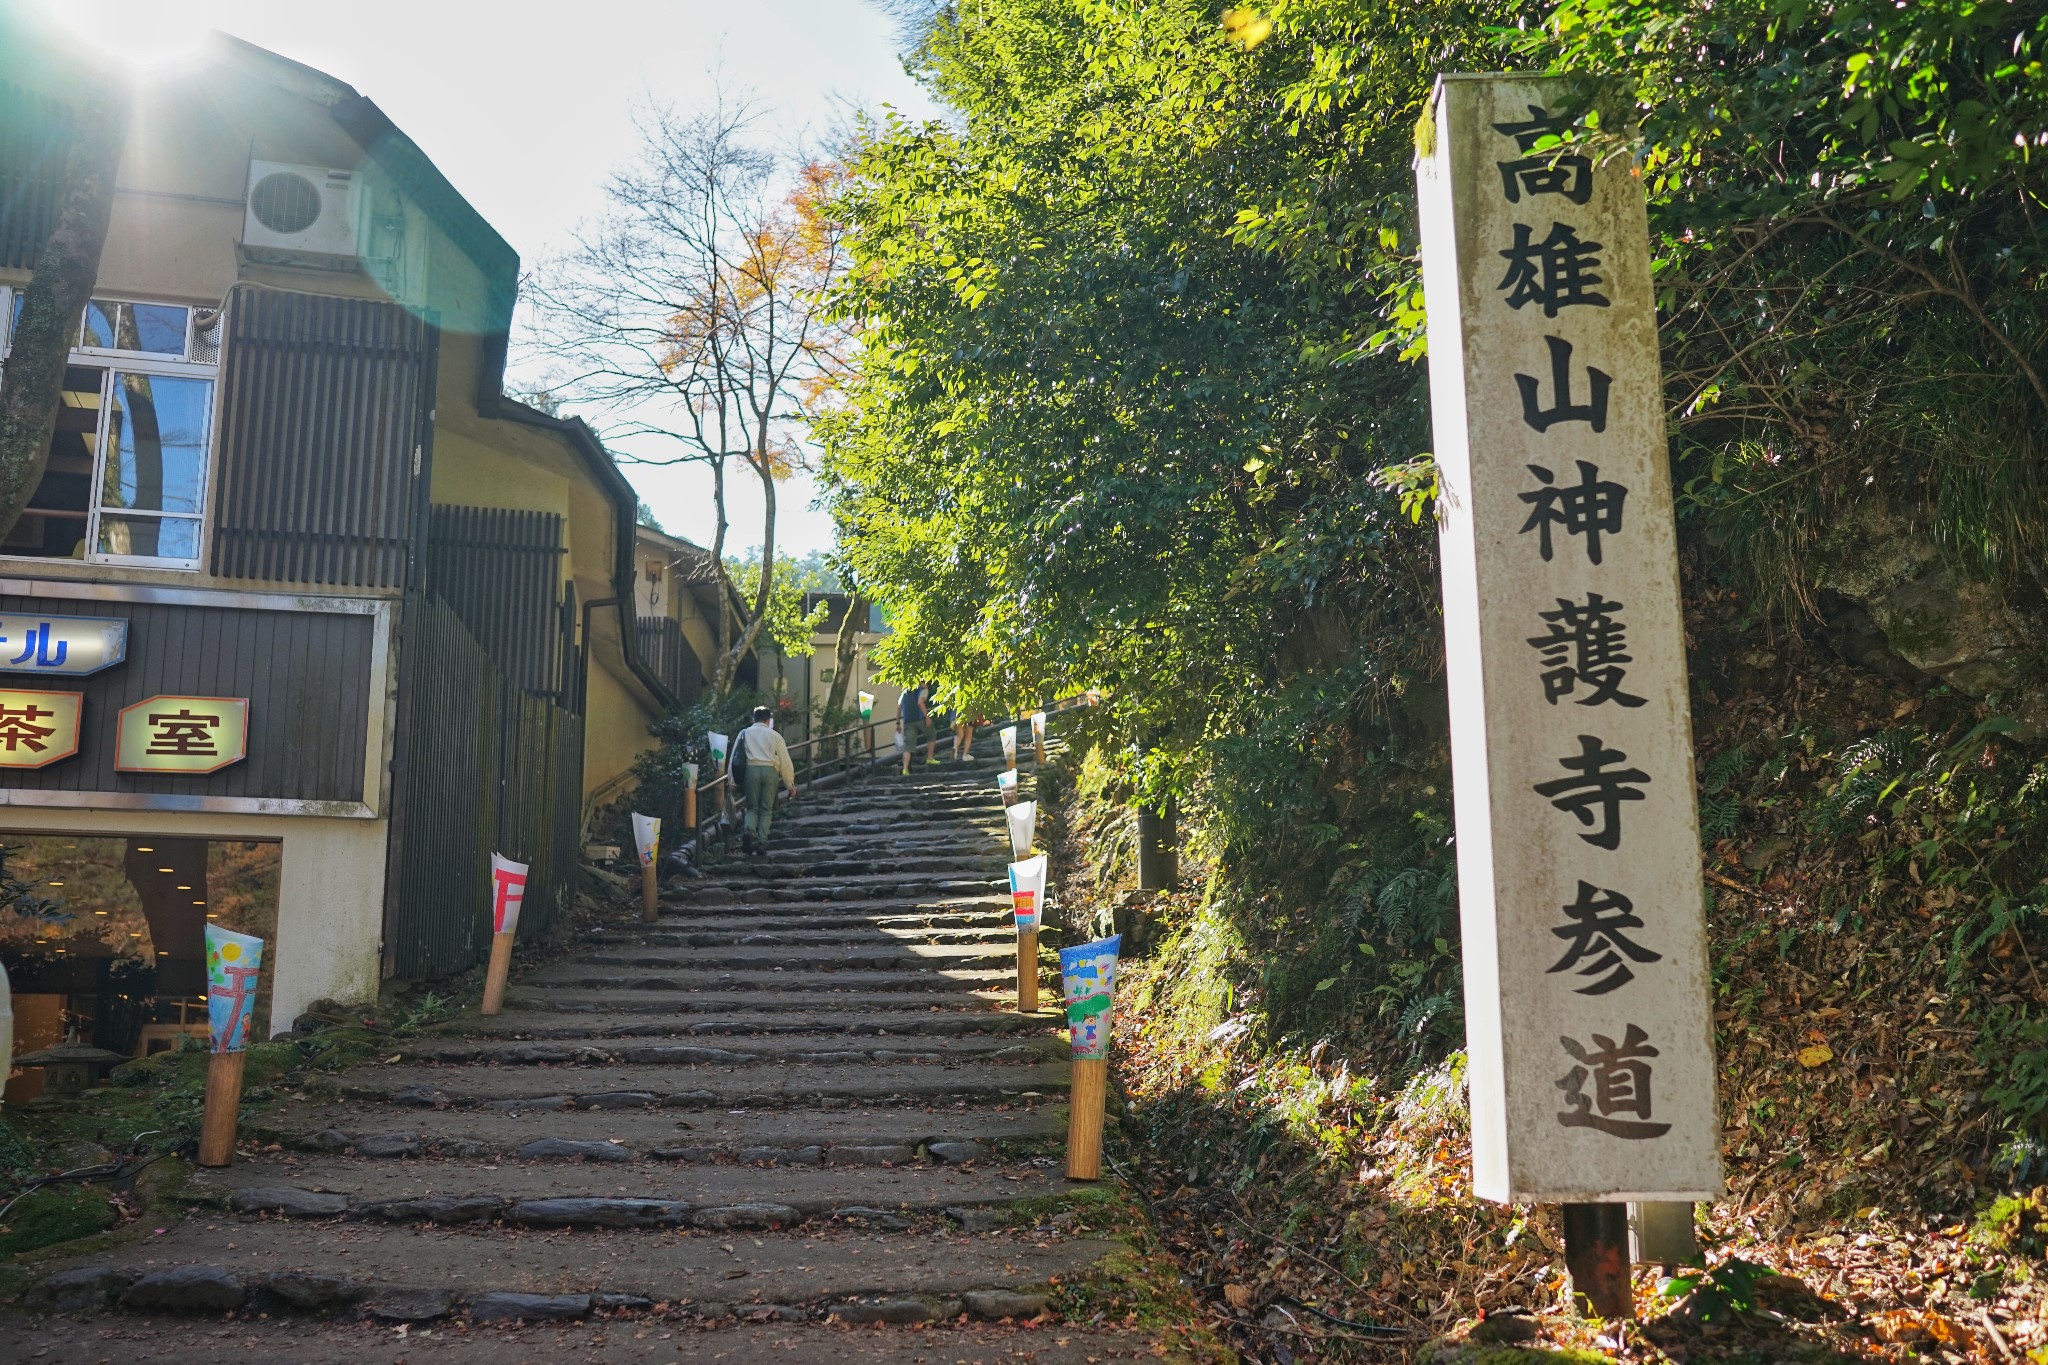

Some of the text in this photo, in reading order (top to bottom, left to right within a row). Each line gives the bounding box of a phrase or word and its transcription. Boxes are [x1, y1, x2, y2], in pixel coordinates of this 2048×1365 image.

[1491, 105, 1673, 1140] 高雄山神護寺参道
